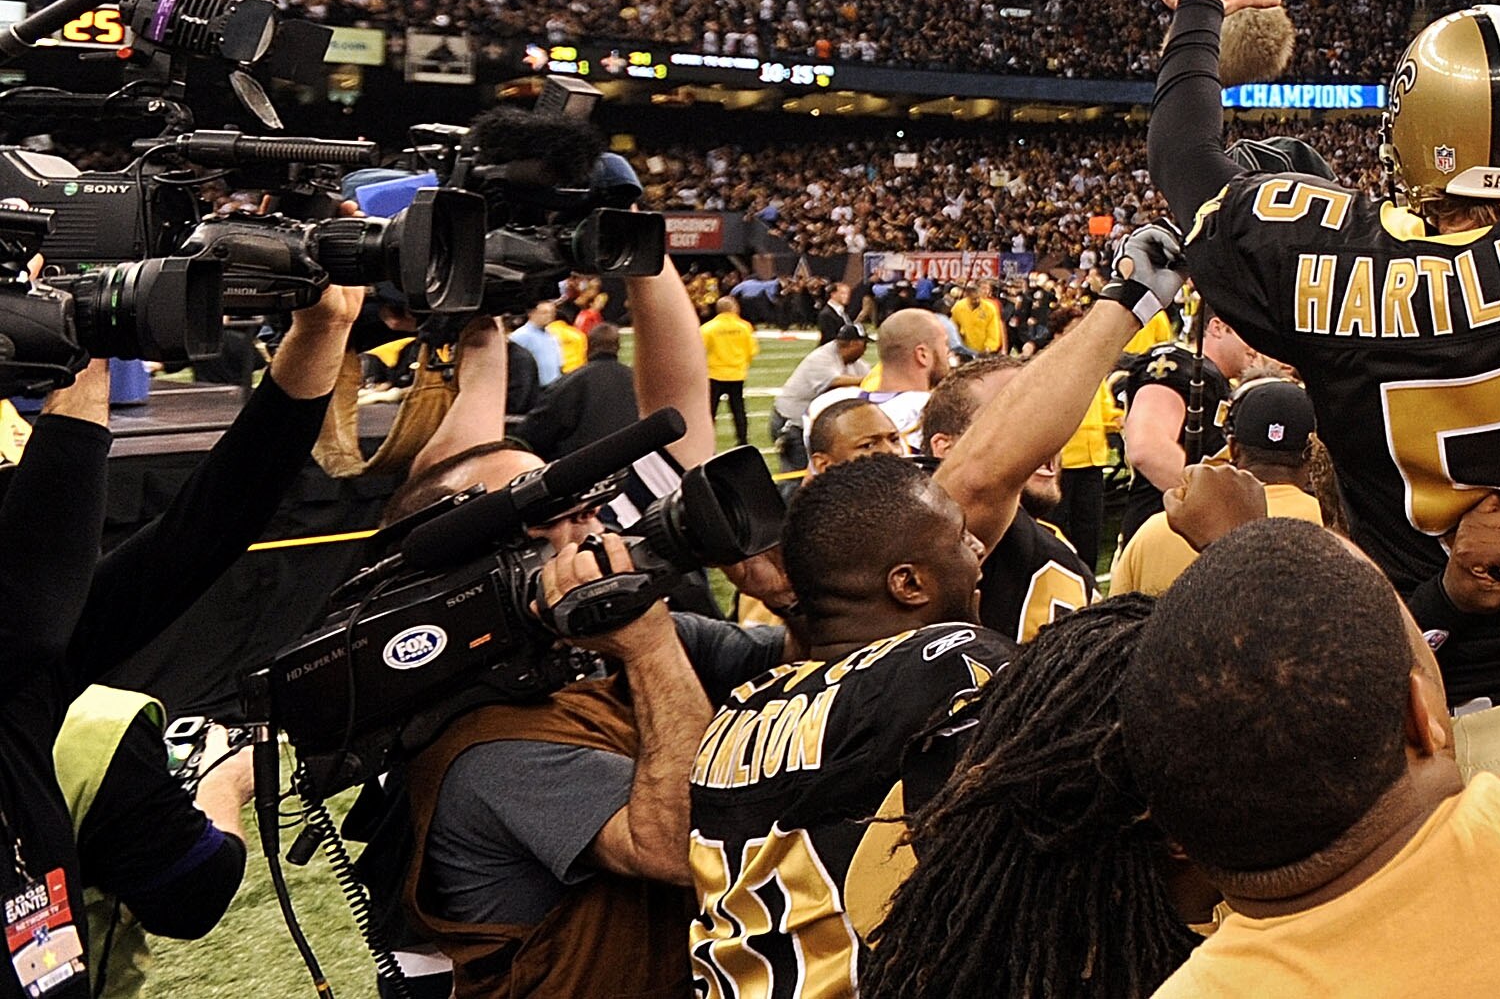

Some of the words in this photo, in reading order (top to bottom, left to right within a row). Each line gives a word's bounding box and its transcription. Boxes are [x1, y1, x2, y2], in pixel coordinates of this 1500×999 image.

[63, 9, 125, 43] 25
[1239, 83, 1363, 109] CHAMPIONS
[83, 184, 130, 194] SONY
[904, 256, 993, 281] PLAYOFFS
[446, 583, 486, 608] SONY
[395, 632, 433, 658] FOX
[286, 666, 302, 682] HD
[5, 892, 49, 924] SAINTS
